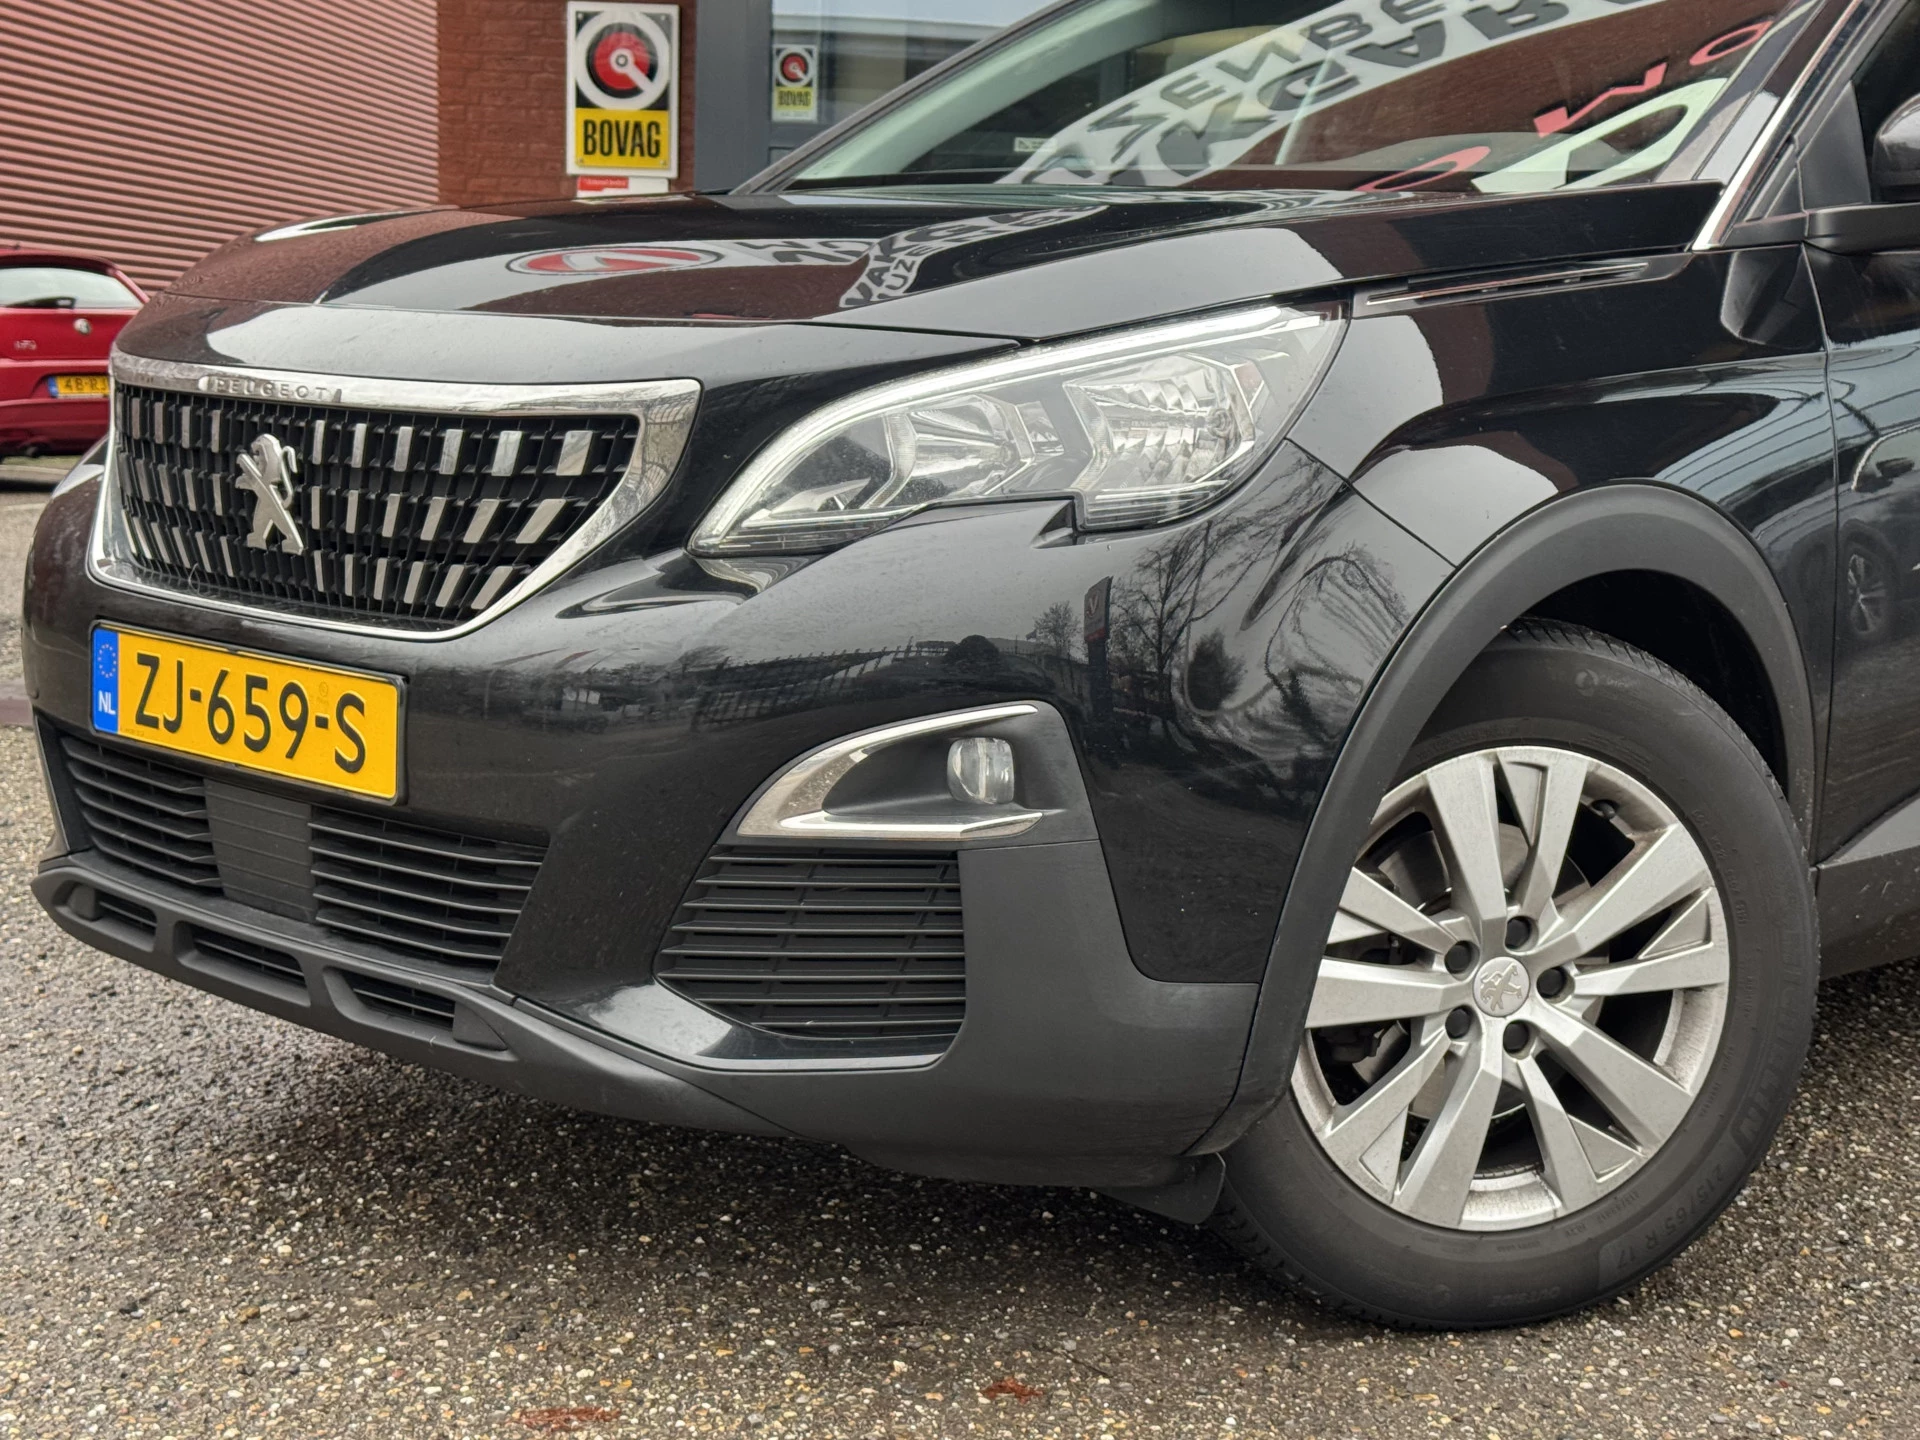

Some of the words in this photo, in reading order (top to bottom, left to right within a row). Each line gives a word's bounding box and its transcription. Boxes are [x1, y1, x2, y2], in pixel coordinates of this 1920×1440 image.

[583, 119, 661, 158] BOVAG
[215, 377, 328, 401] PEUGEOT
[97, 690, 117, 715] NL
[135, 650, 367, 774] ZJ-659-S
